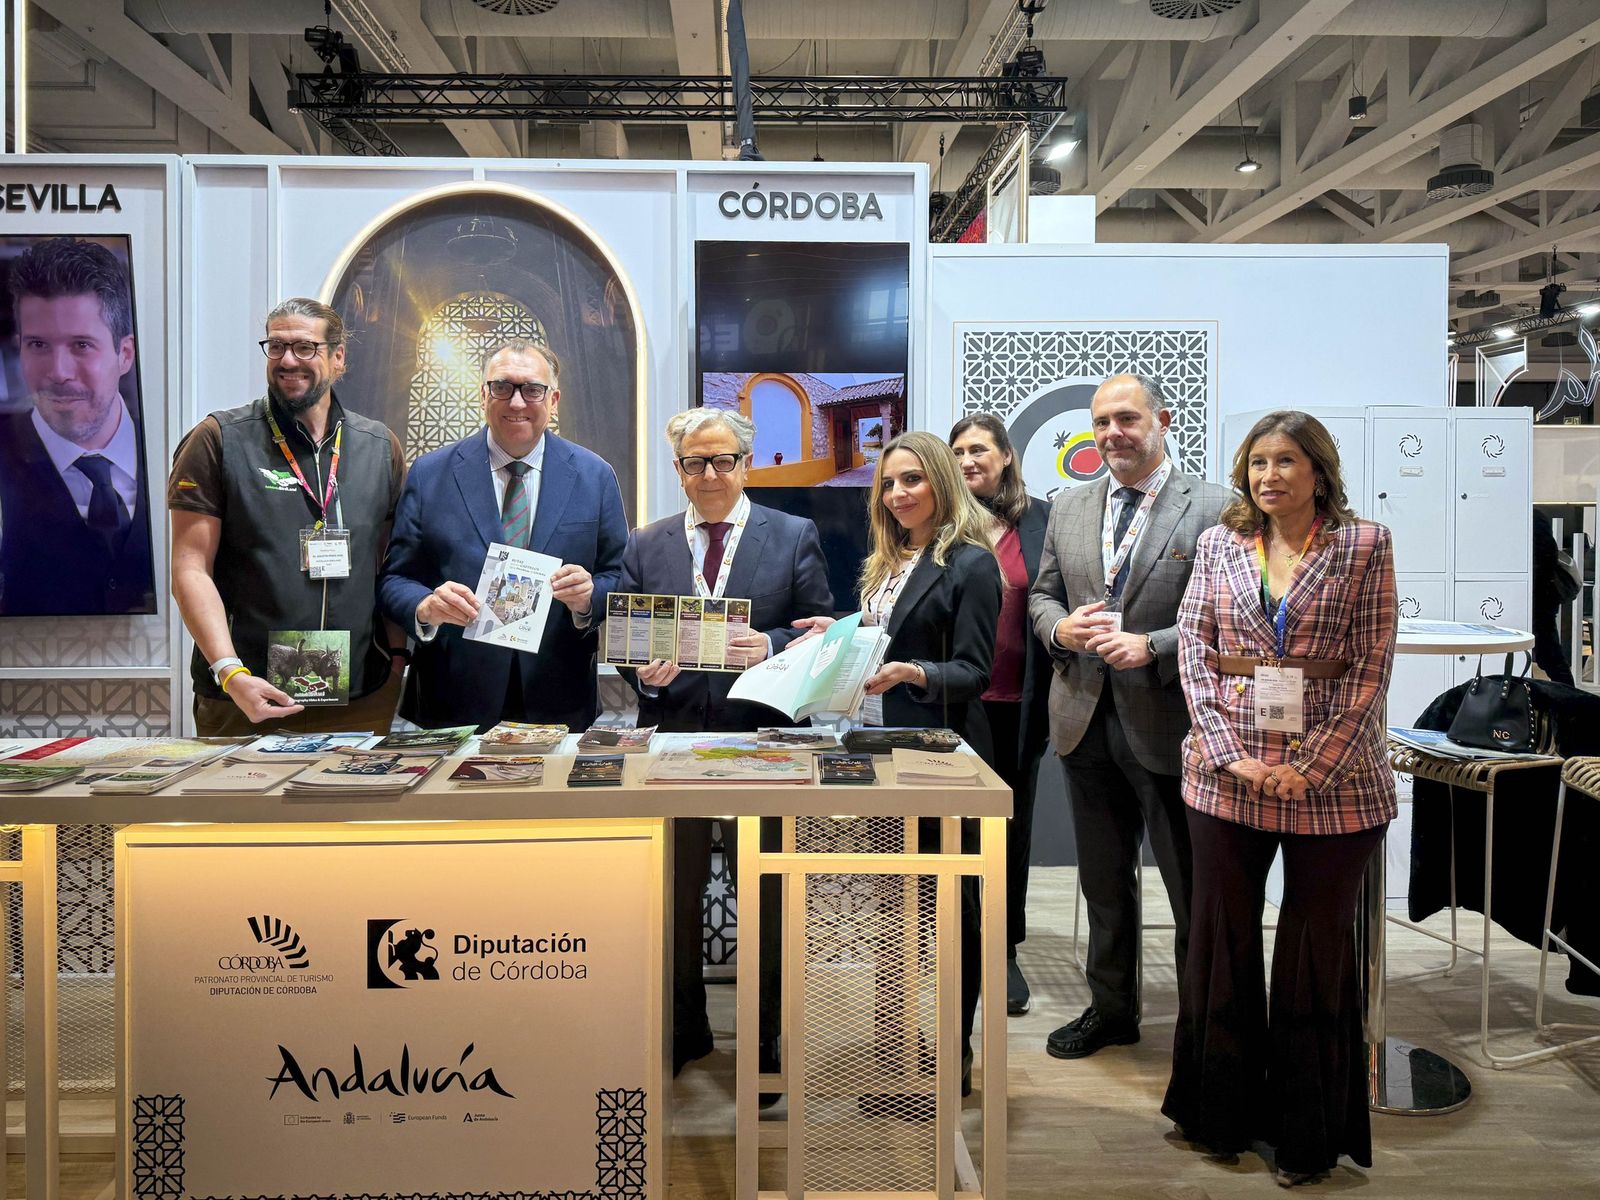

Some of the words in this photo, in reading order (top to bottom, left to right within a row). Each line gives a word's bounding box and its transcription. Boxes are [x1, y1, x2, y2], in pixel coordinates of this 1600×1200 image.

[0, 183, 122, 212] EVILLA
[718, 182, 883, 219] CÓRDOBA
[1260, 707, 1267, 717] E
[1493, 729, 1510, 740] NC
[453, 932, 587, 959] Diputación
[218, 953, 284, 974] CÓRDOBA
[452, 961, 481, 981] de
[490, 960, 588, 981] Córdoba
[194, 975, 239, 984] PATRONATO
[240, 974, 286, 983] PROVINCIAL
[287, 974, 298, 982] DE
[300, 974, 334, 982] TURISMO
[210, 985, 261, 996] DIPUTACIÓN
[263, 986, 274, 995] DE
[276, 984, 317, 995] CÓRDOBA
[265, 1041, 517, 1103] Andalucía
